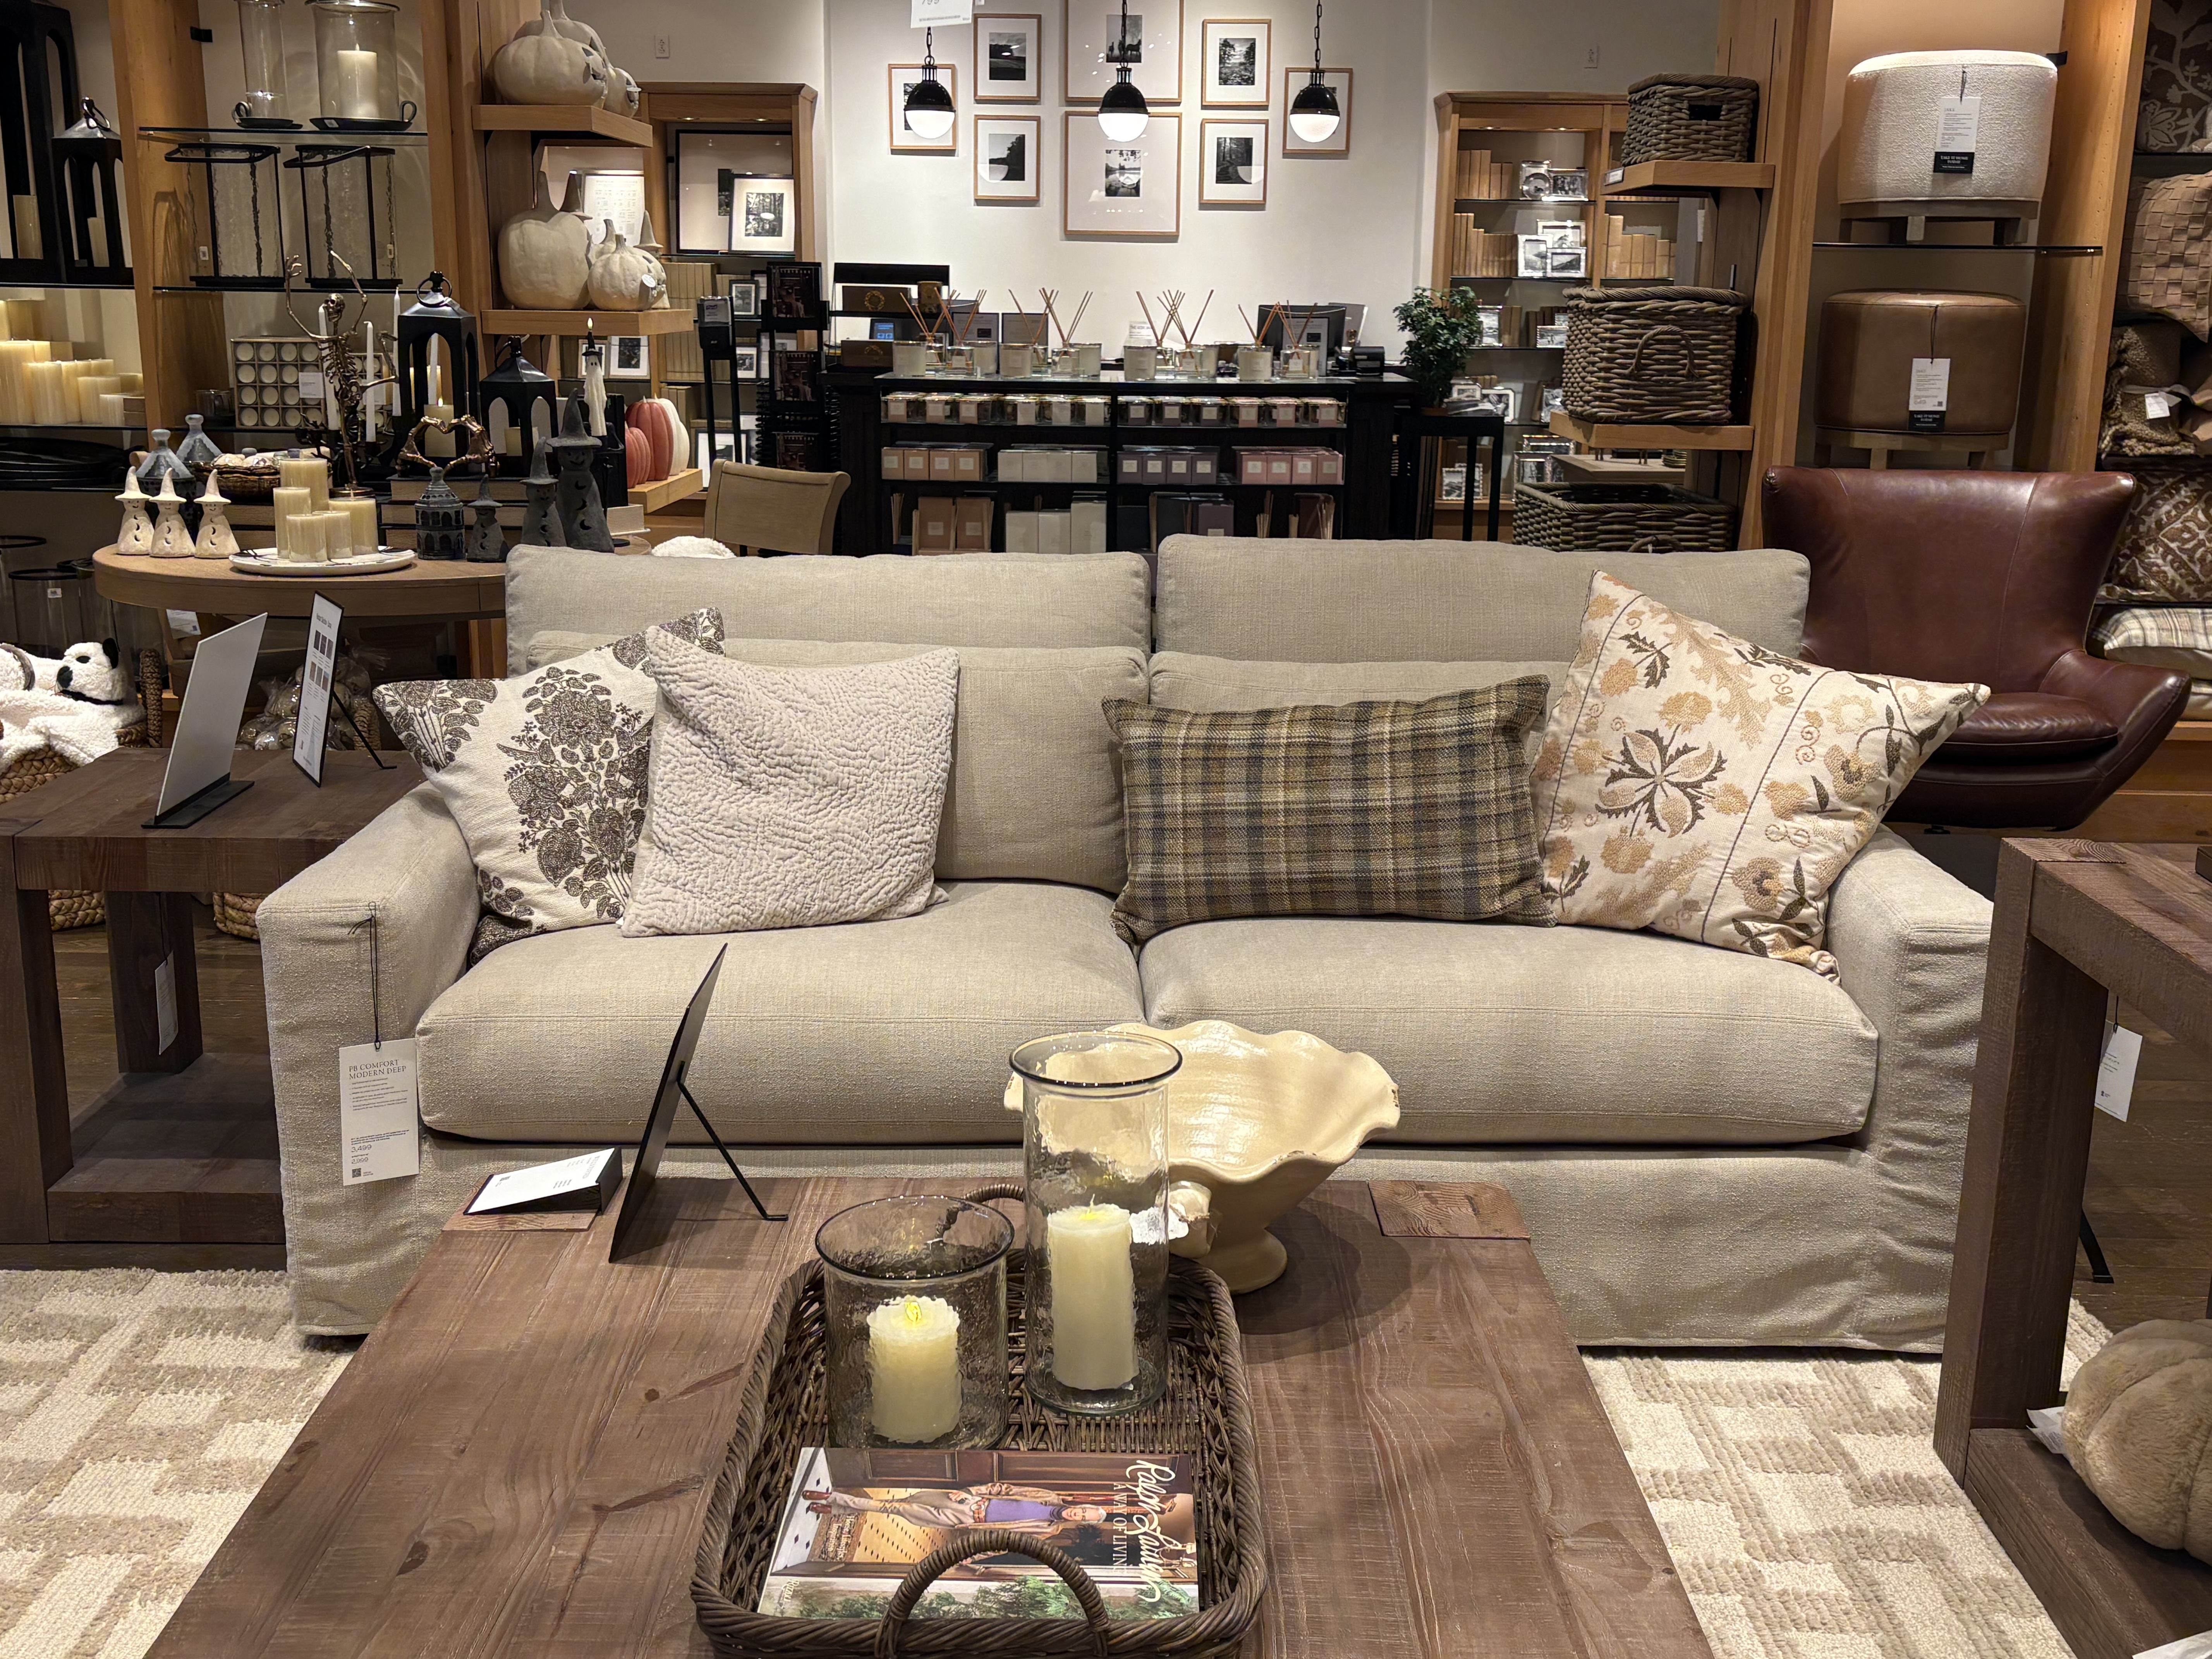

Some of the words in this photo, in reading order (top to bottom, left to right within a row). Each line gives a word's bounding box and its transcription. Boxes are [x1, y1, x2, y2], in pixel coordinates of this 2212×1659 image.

[349, 1068, 385, 1079] MODERN
[387, 1065, 406, 1074] DEEP
[360, 1059, 399, 1070] COMFORT
[351, 1144, 372, 1152] 3,499
[1125, 1460, 1176, 1530] Ralph
[1113, 1493, 1127, 1515] WAY
[1113, 1517, 1127, 1532] OF
[1124, 1515, 1183, 1602] Lauren
